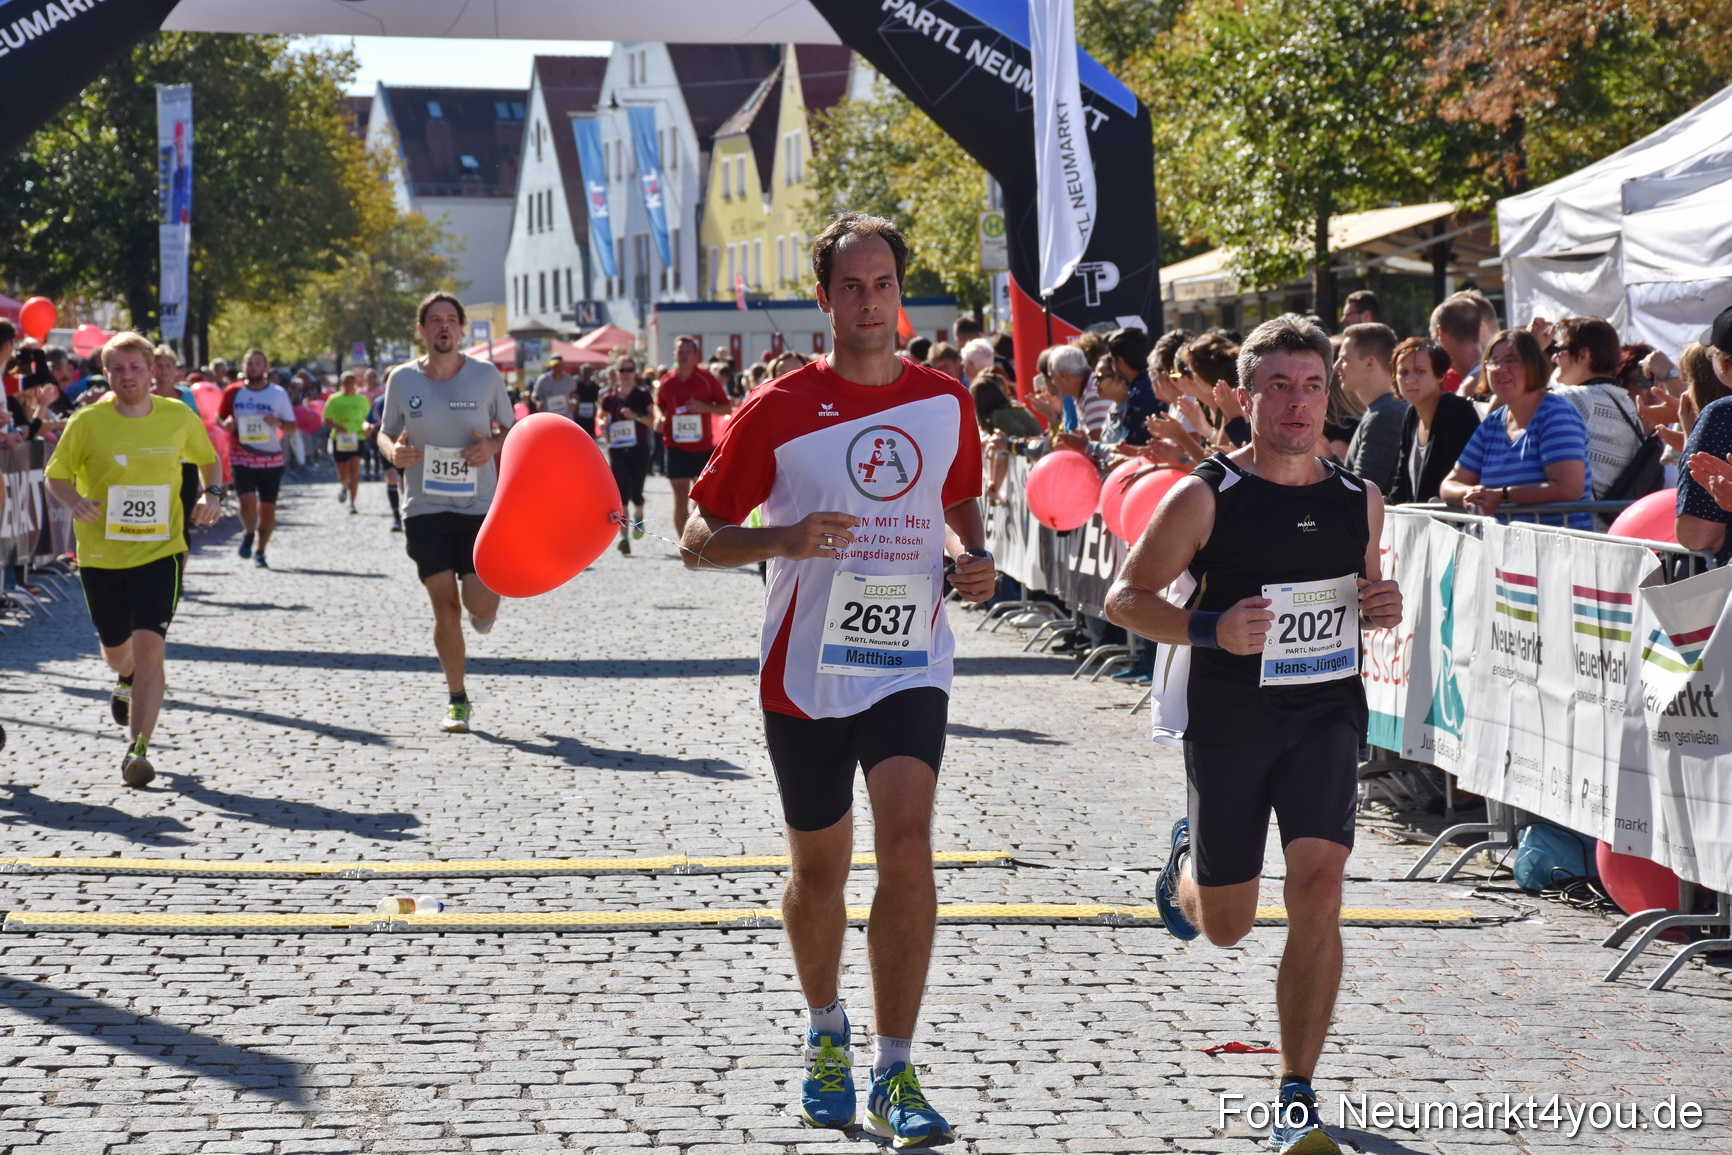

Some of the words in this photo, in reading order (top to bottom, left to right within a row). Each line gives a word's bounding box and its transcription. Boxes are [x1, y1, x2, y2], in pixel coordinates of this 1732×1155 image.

[880, 0, 961, 54] PARTL
[1056, 99, 1086, 210] NEUMARKT
[246, 423, 262, 432] 221
[432, 460, 468, 476] 3154
[123, 500, 156, 517] 293
[119, 526, 156, 534] Alexander
[876, 517, 899, 527] MIT
[879, 535, 893, 544] Dr.
[895, 535, 924, 545] Röschl
[865, 585, 906, 596] BOCK
[1293, 588, 1337, 604] BOCK
[840, 601, 917, 636] 2637
[1279, 606, 1347, 644] 2027
[845, 635, 867, 643] PARTL
[869, 638, 901, 646] Neumarkt
[1308, 643, 1335, 652] Neumarkt
[846, 649, 903, 666] Matthias
[1275, 654, 1348, 674] Hans-Jürgen
[1614, 819, 1649, 834] markt
